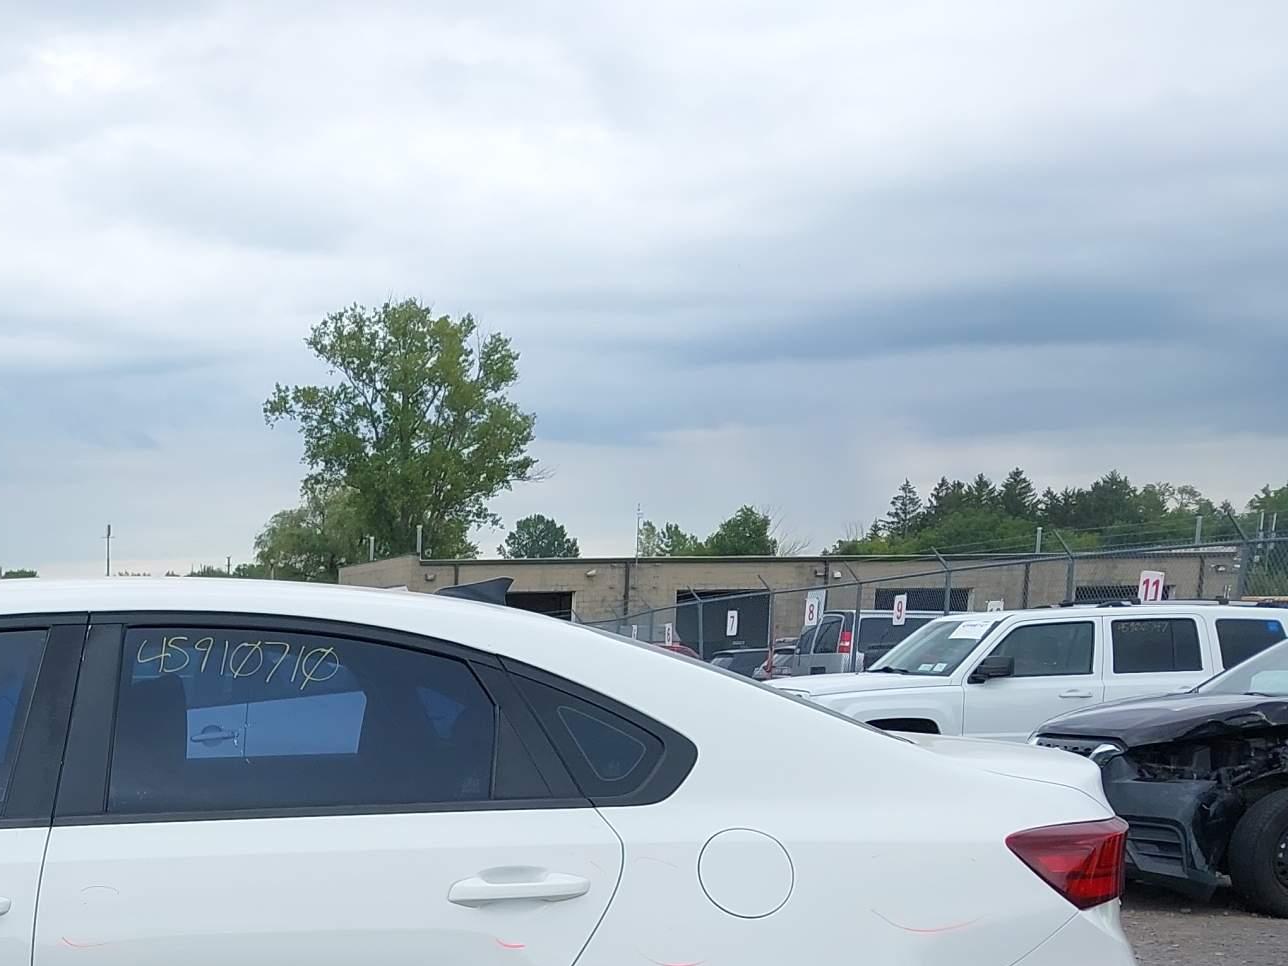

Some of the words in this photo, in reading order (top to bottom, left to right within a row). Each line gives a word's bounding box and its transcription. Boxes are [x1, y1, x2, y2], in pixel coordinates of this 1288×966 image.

[1142, 578, 1161, 601] 11
[807, 603, 815, 621] 8
[896, 600, 903, 620] 9
[137, 636, 340, 691] 45910710
